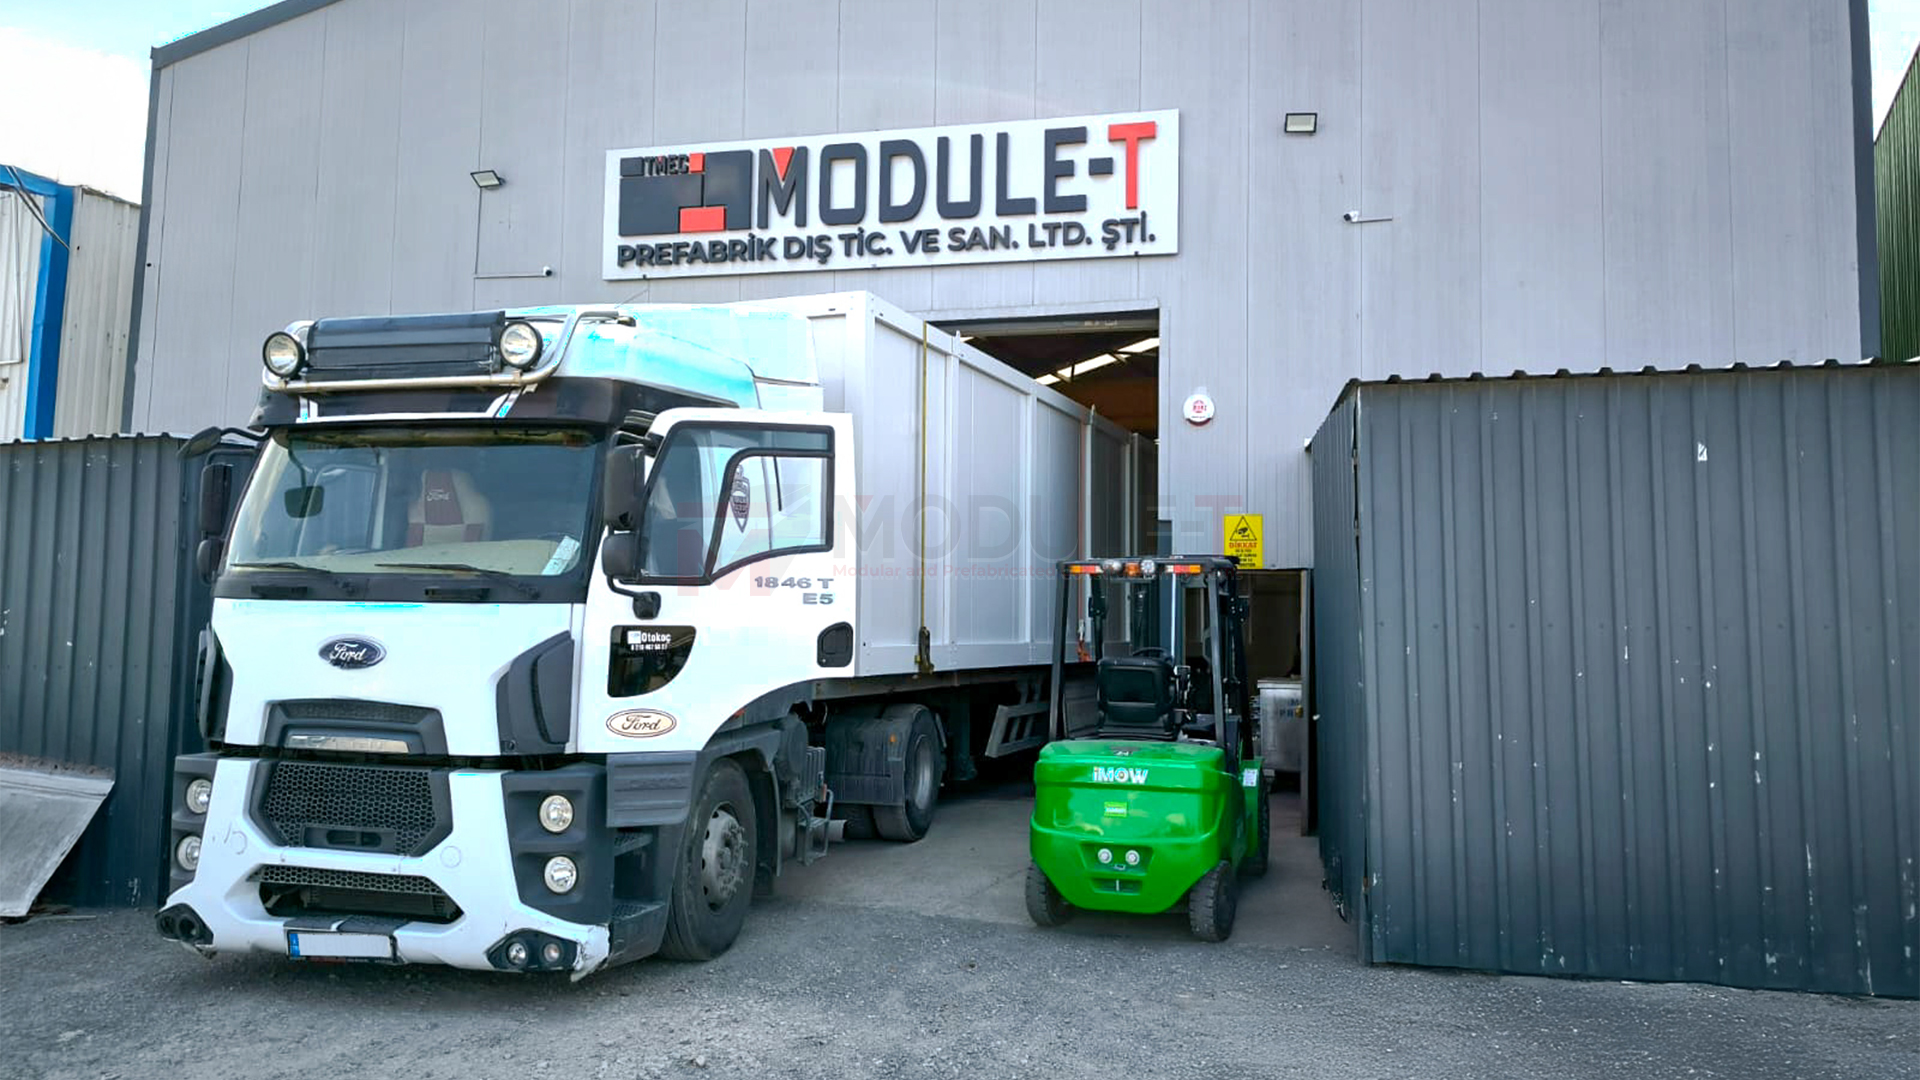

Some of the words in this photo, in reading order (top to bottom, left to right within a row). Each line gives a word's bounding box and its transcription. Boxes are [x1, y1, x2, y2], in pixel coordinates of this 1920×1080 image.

[757, 121, 1157, 229] MODULE-T
[617, 232, 778, 268] PREFABRİK
[783, 234, 833, 264] DIŞ
[838, 226, 894, 258] TİC.
[899, 229, 941, 255] VE
[947, 224, 1020, 252] SAN.
[1027, 221, 1093, 249] LTD.
[1101, 210, 1157, 251] ŞTİ.
[754, 576, 812, 589] 1846
[817, 578, 834, 589] T
[802, 592, 834, 605] E5
[641, 632, 672, 644] Otokoç
[329, 642, 368, 662] Ford
[621, 714, 662, 731] Ford
[1092, 766, 1149, 785] iMOW
